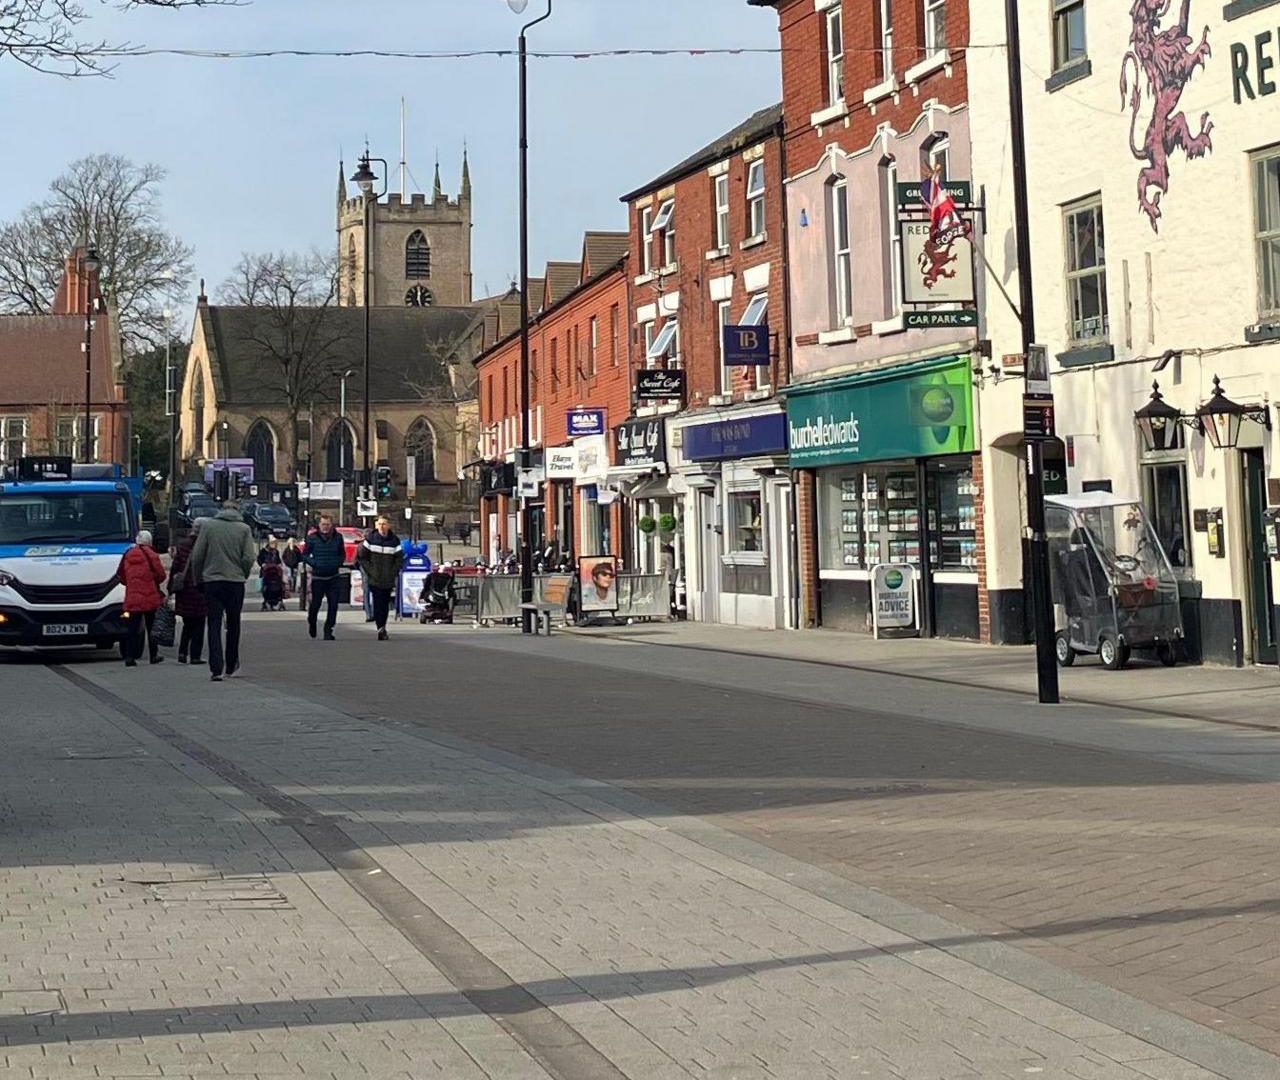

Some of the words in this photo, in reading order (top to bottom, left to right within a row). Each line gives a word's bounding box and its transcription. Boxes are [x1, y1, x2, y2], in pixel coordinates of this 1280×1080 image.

[907, 225, 930, 236] RED
[908, 314, 929, 324] CAR
[931, 314, 959, 324] PARK
[549, 462, 575, 470] Travel
[878, 599, 910, 612] ADVICE
